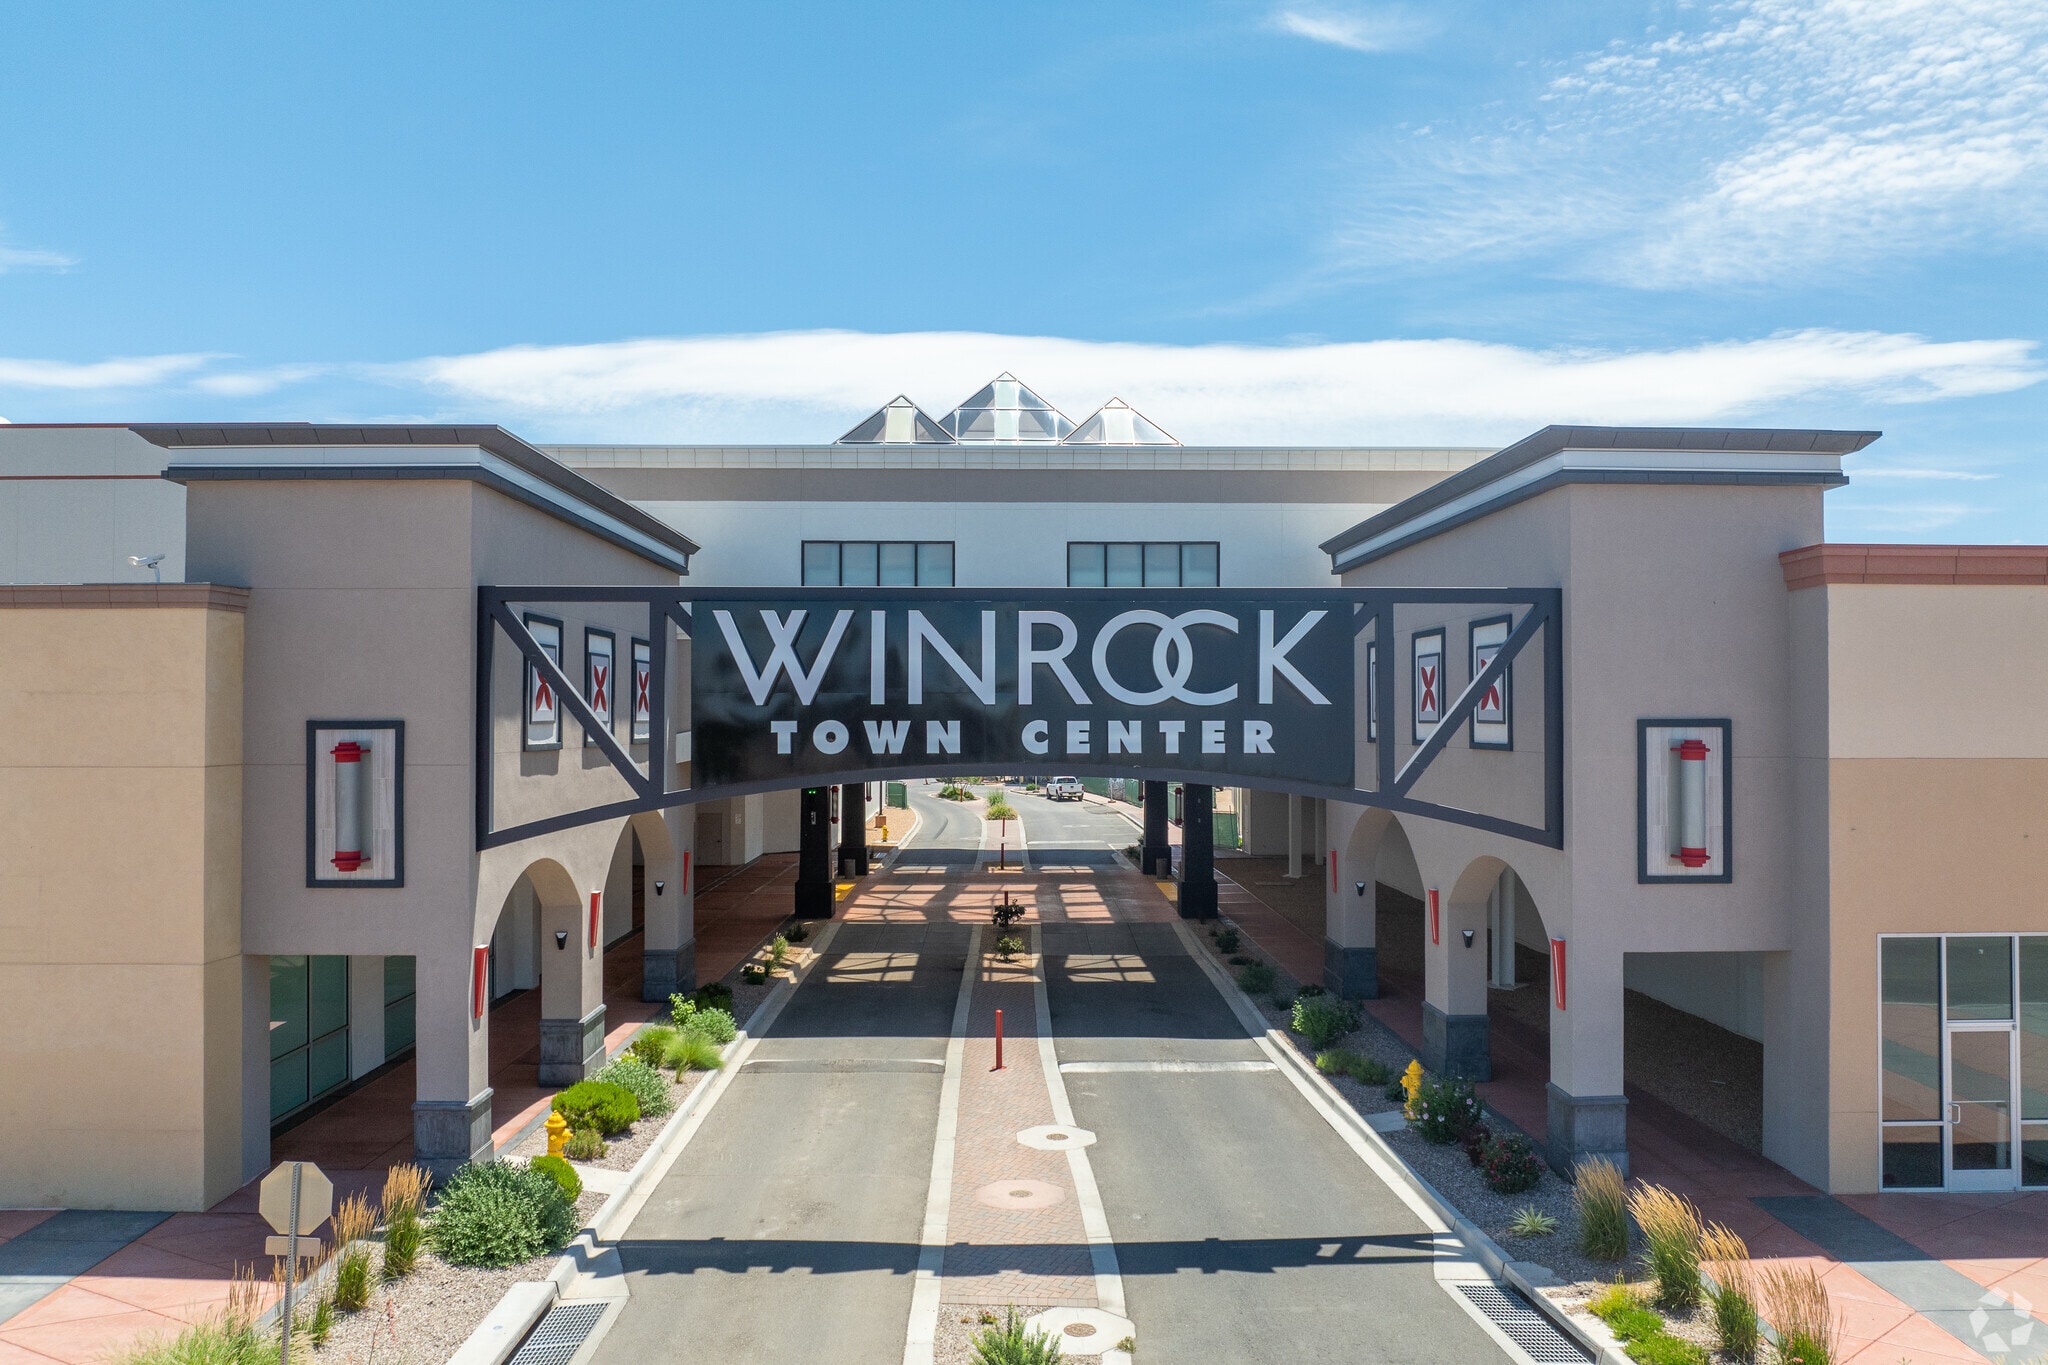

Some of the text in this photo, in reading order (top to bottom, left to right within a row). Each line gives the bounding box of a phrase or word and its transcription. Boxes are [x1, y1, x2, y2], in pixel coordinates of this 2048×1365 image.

[712, 609, 1332, 706] WINROCK
[770, 719, 1276, 756] TOWN CENTER
